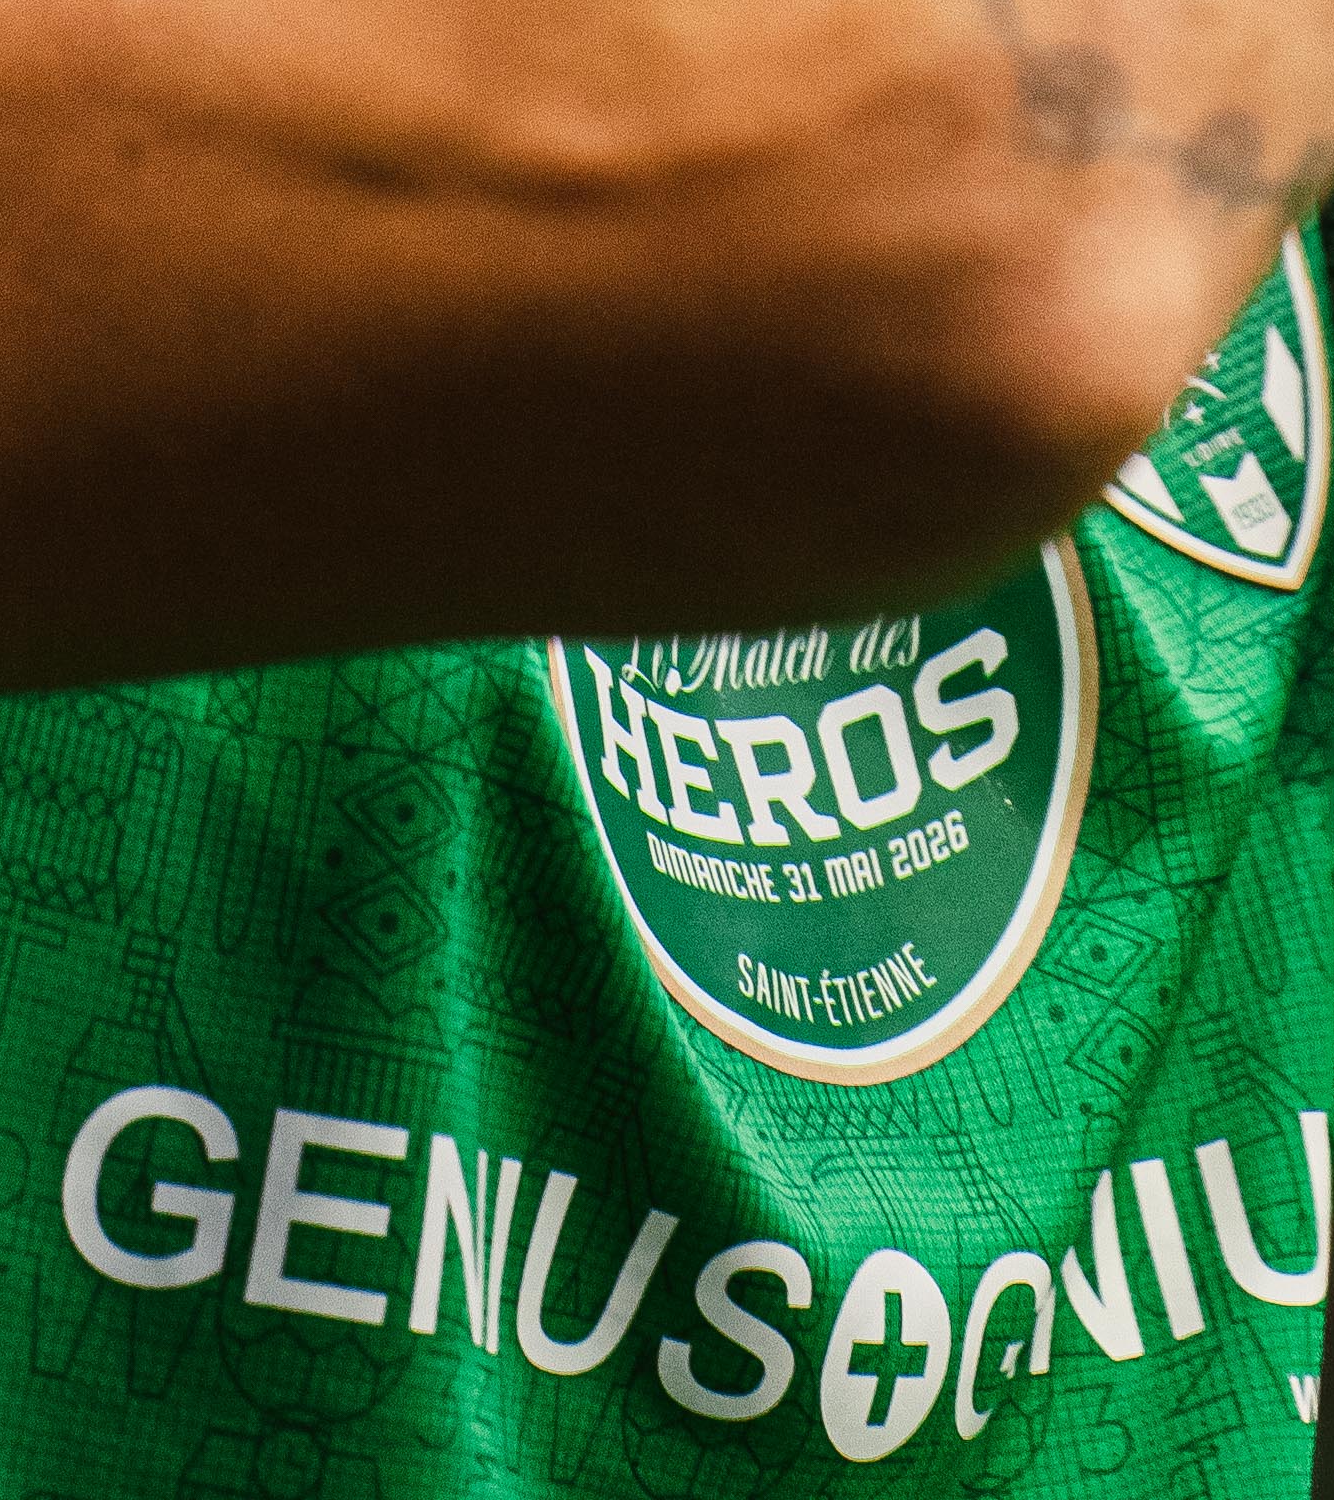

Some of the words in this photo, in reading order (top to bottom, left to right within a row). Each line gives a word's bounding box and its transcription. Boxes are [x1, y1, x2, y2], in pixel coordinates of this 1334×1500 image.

[582, 627, 1021, 848] HEROS
[646, 831, 781, 903] DIMANCHE
[782, 862, 823, 904] 31
[824, 847, 885, 899] MAI
[888, 810, 970, 881] 2026
[737, 941, 938, 1027] SAINT-ÉTIENNE
[62, 1084, 813, 1421] GENIUS
